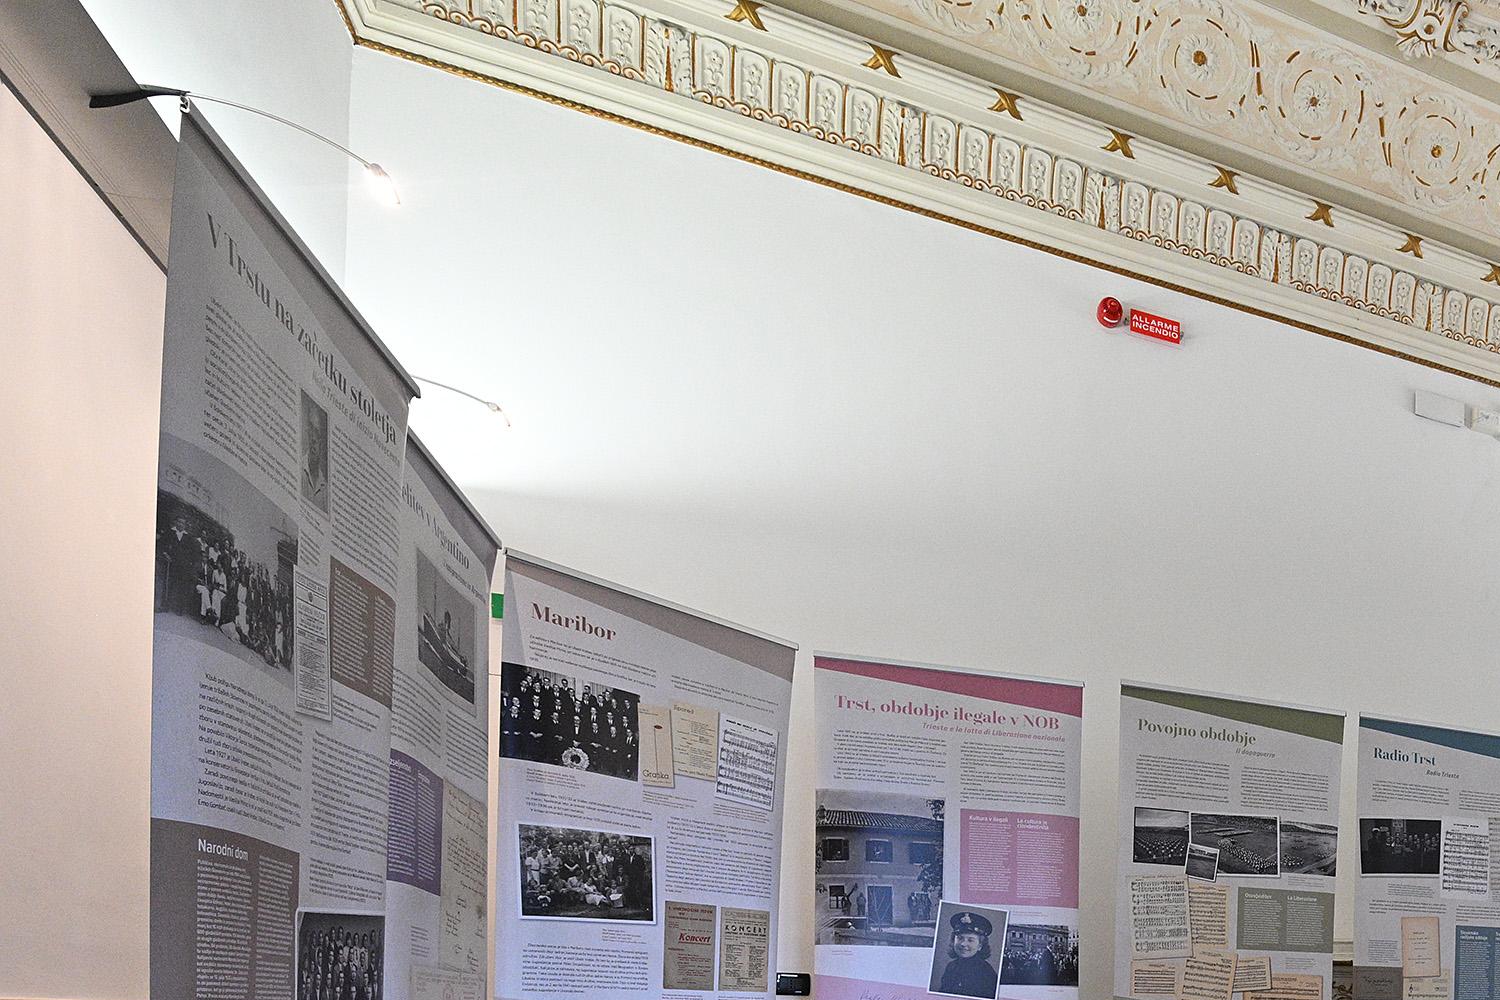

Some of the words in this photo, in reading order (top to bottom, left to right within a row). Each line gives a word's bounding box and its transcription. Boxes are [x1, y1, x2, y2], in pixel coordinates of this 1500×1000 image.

[208, 212, 221, 248] V
[224, 232, 270, 308] Trstu
[274, 297, 294, 335] na
[298, 324, 347, 395] začetku
[350, 385, 397, 445] stoletja
[1132, 314, 1179, 333] ALLARME
[1132, 321, 1179, 339] INCENDIO
[432, 516, 470, 569] Argentino
[531, 602, 616, 640] Maribor
[834, 694, 876, 713] Trst,
[880, 699, 949, 721] obdobje
[953, 707, 1006, 725] ilegale
[1010, 717, 1018, 725] v
[1024, 714, 1059, 730] NOB
[922, 722, 948, 732] Trieste
[992, 729, 1031, 739] Liberazione
[1138, 718, 1196, 738] Povojno
[1200, 727, 1256, 747] obdobje
[1373, 747, 1409, 762] Radio
[1412, 752, 1436, 766] Trst
[198, 838, 234, 857] Narodni
[234, 848, 249, 861] dom
[679, 933, 711, 943] Koncert
[725, 925, 767, 934] KONCERT
